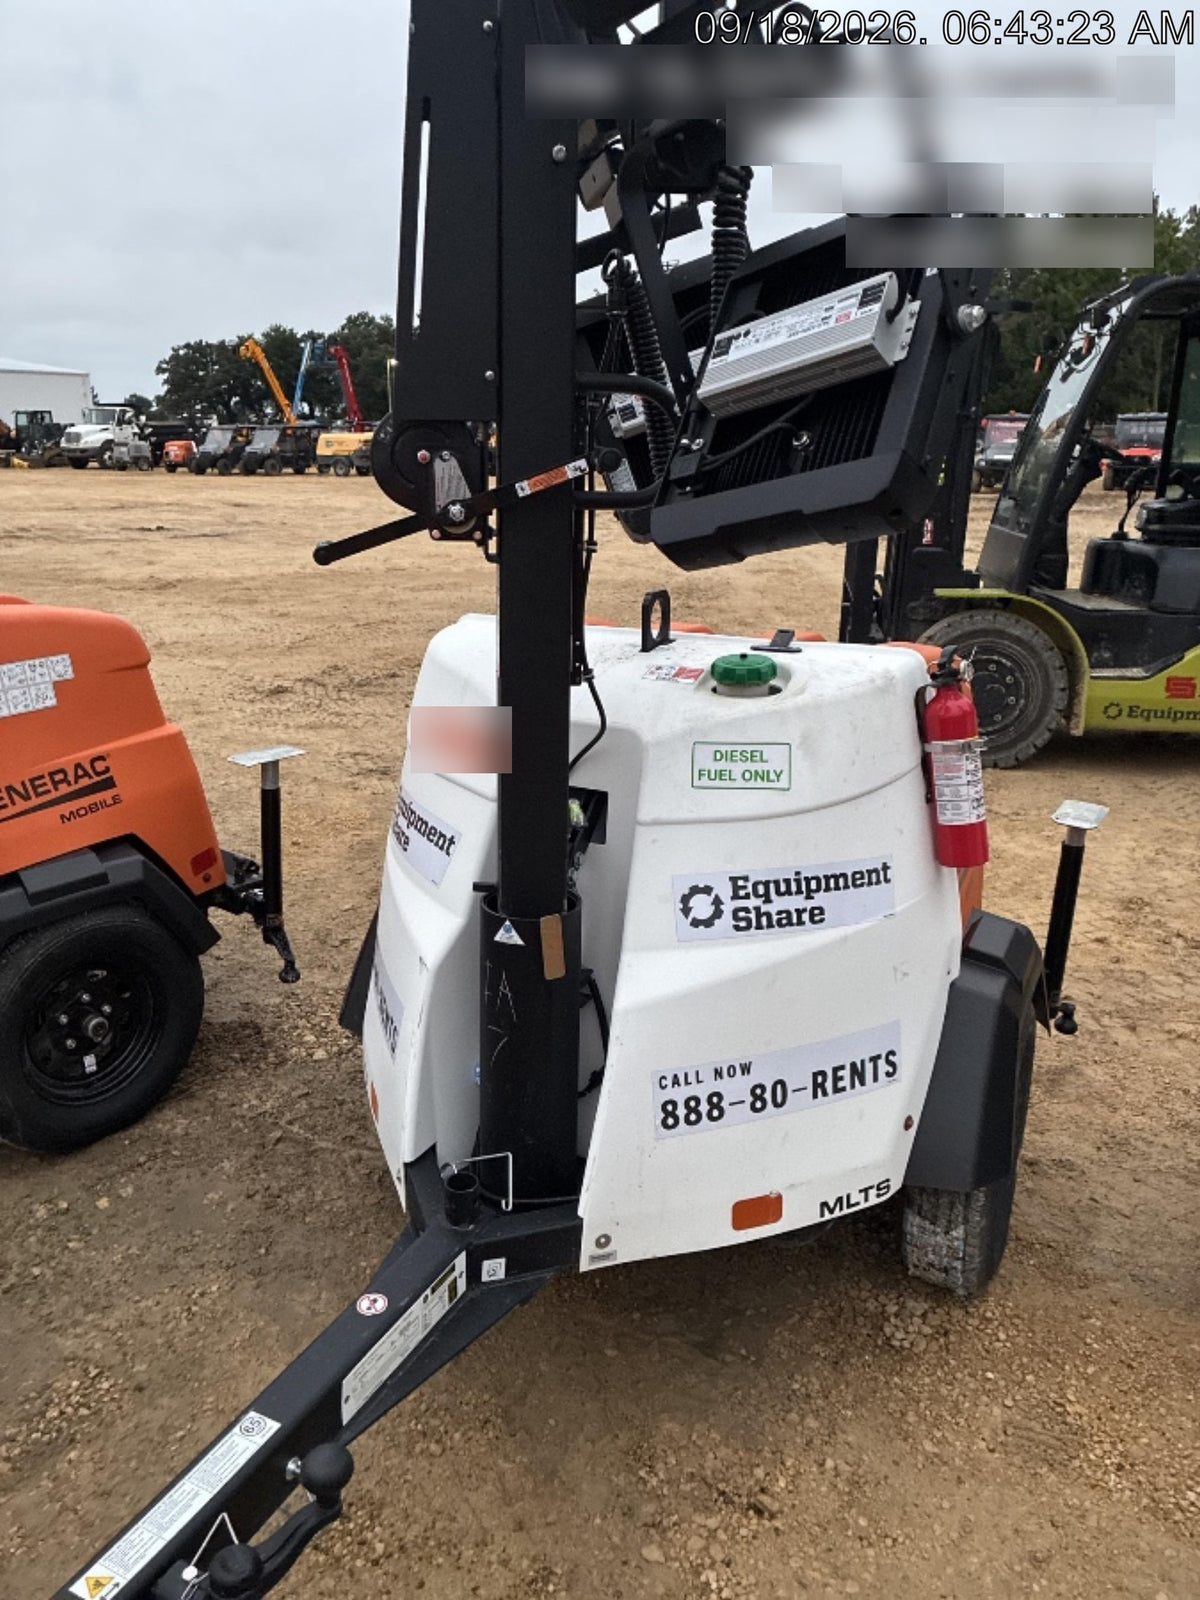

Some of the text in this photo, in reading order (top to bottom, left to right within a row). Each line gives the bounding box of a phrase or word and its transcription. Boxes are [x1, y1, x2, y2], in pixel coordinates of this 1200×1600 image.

[713, 750, 769, 763] DIESEL
[698, 769, 784, 783] FUEL ONLY
[60, 794, 122, 824] MOBILE
[729, 862, 892, 905] Equipment
[731, 905, 826, 932] Share
[658, 1061, 753, 1090] CALL NOW
[660, 1049, 899, 1130] 888-80-RENTS
[819, 1178, 892, 1218] MLTS
